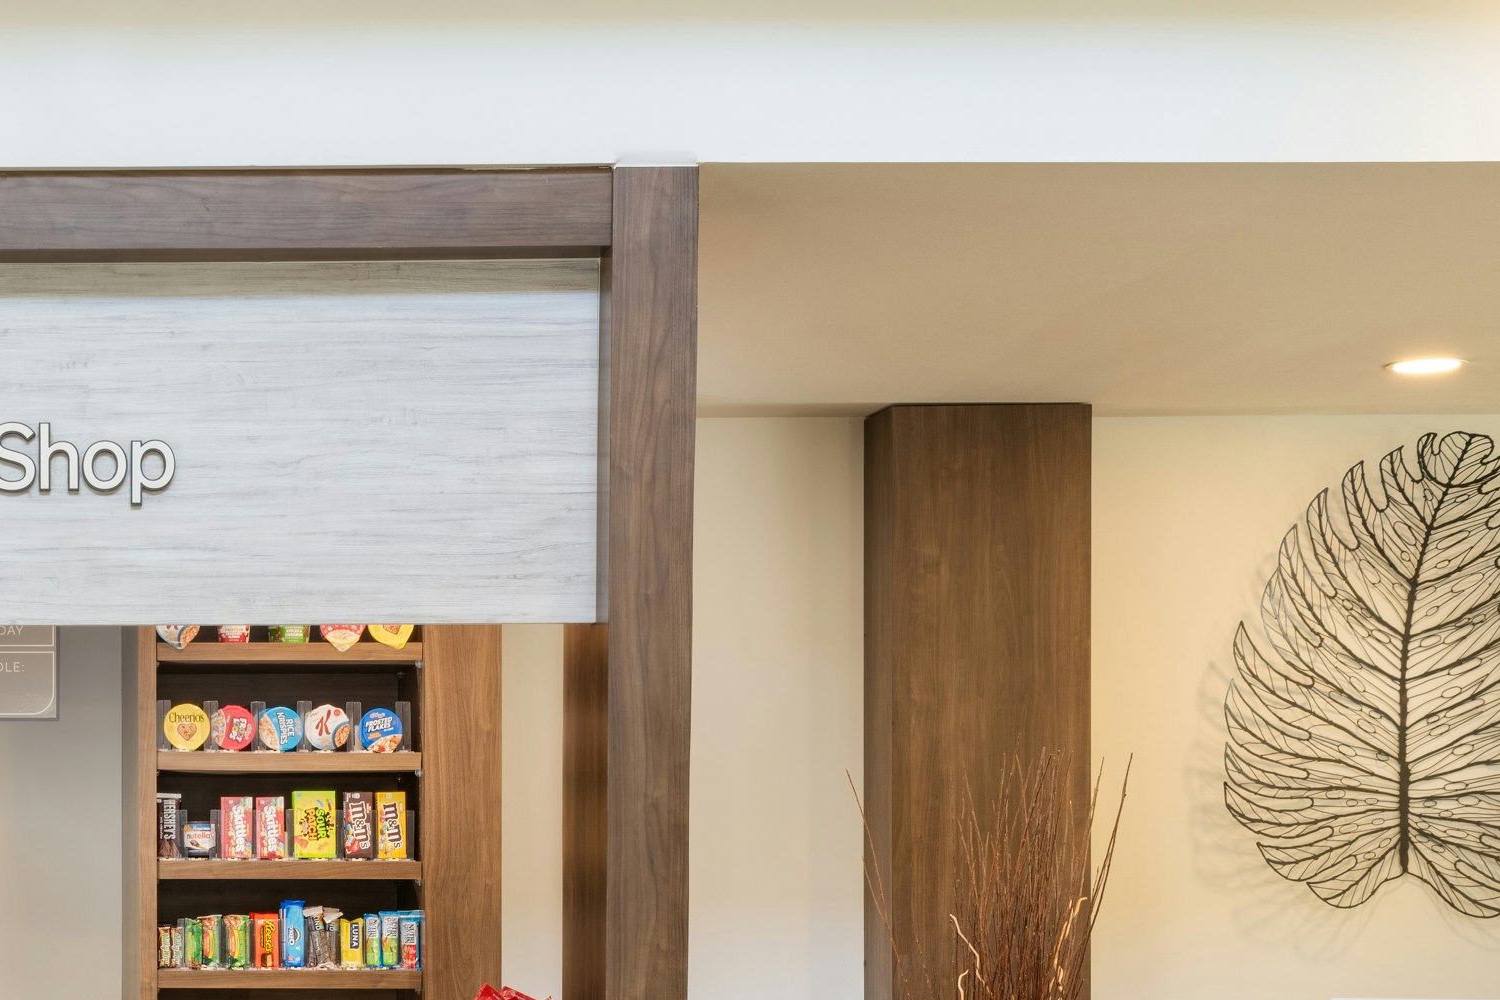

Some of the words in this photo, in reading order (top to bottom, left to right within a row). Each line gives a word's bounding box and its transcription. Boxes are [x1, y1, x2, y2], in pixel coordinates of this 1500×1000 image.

[169, 712, 205, 723] Cheerios
[276, 712, 287, 745] KRISPIES
[164, 799, 176, 840] HERSHEY'S
[233, 806, 245, 852] Skittles
[263, 806, 277, 852] Skittles
[315, 810, 326, 839] SOUR
